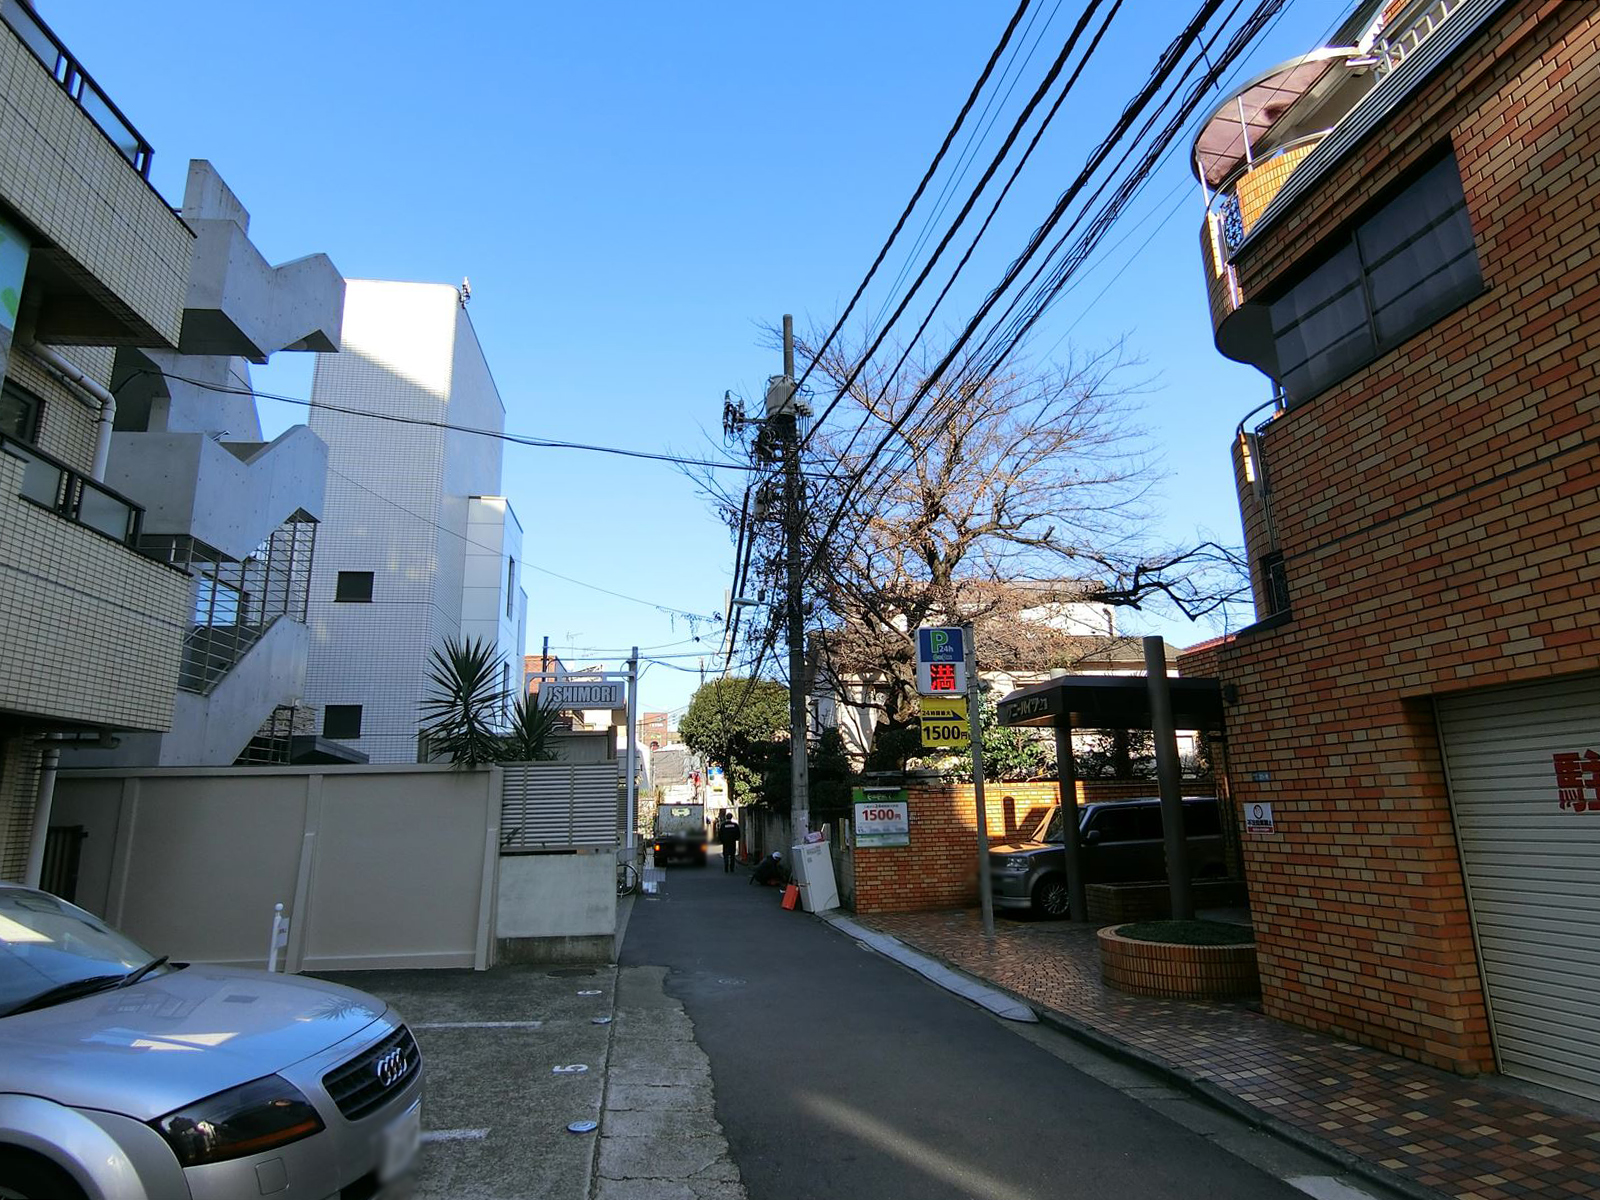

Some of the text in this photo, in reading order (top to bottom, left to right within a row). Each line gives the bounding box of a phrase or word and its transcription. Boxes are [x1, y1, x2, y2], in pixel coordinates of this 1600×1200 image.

[930, 630, 948, 653] P
[939, 645, 954, 653] 24h
[931, 665, 956, 690] 満
[547, 686, 617, 702] ISHIMORI
[923, 726, 968, 740] 1500円
[862, 809, 901, 821] 1500円
[553, 1064, 588, 1072] 5
